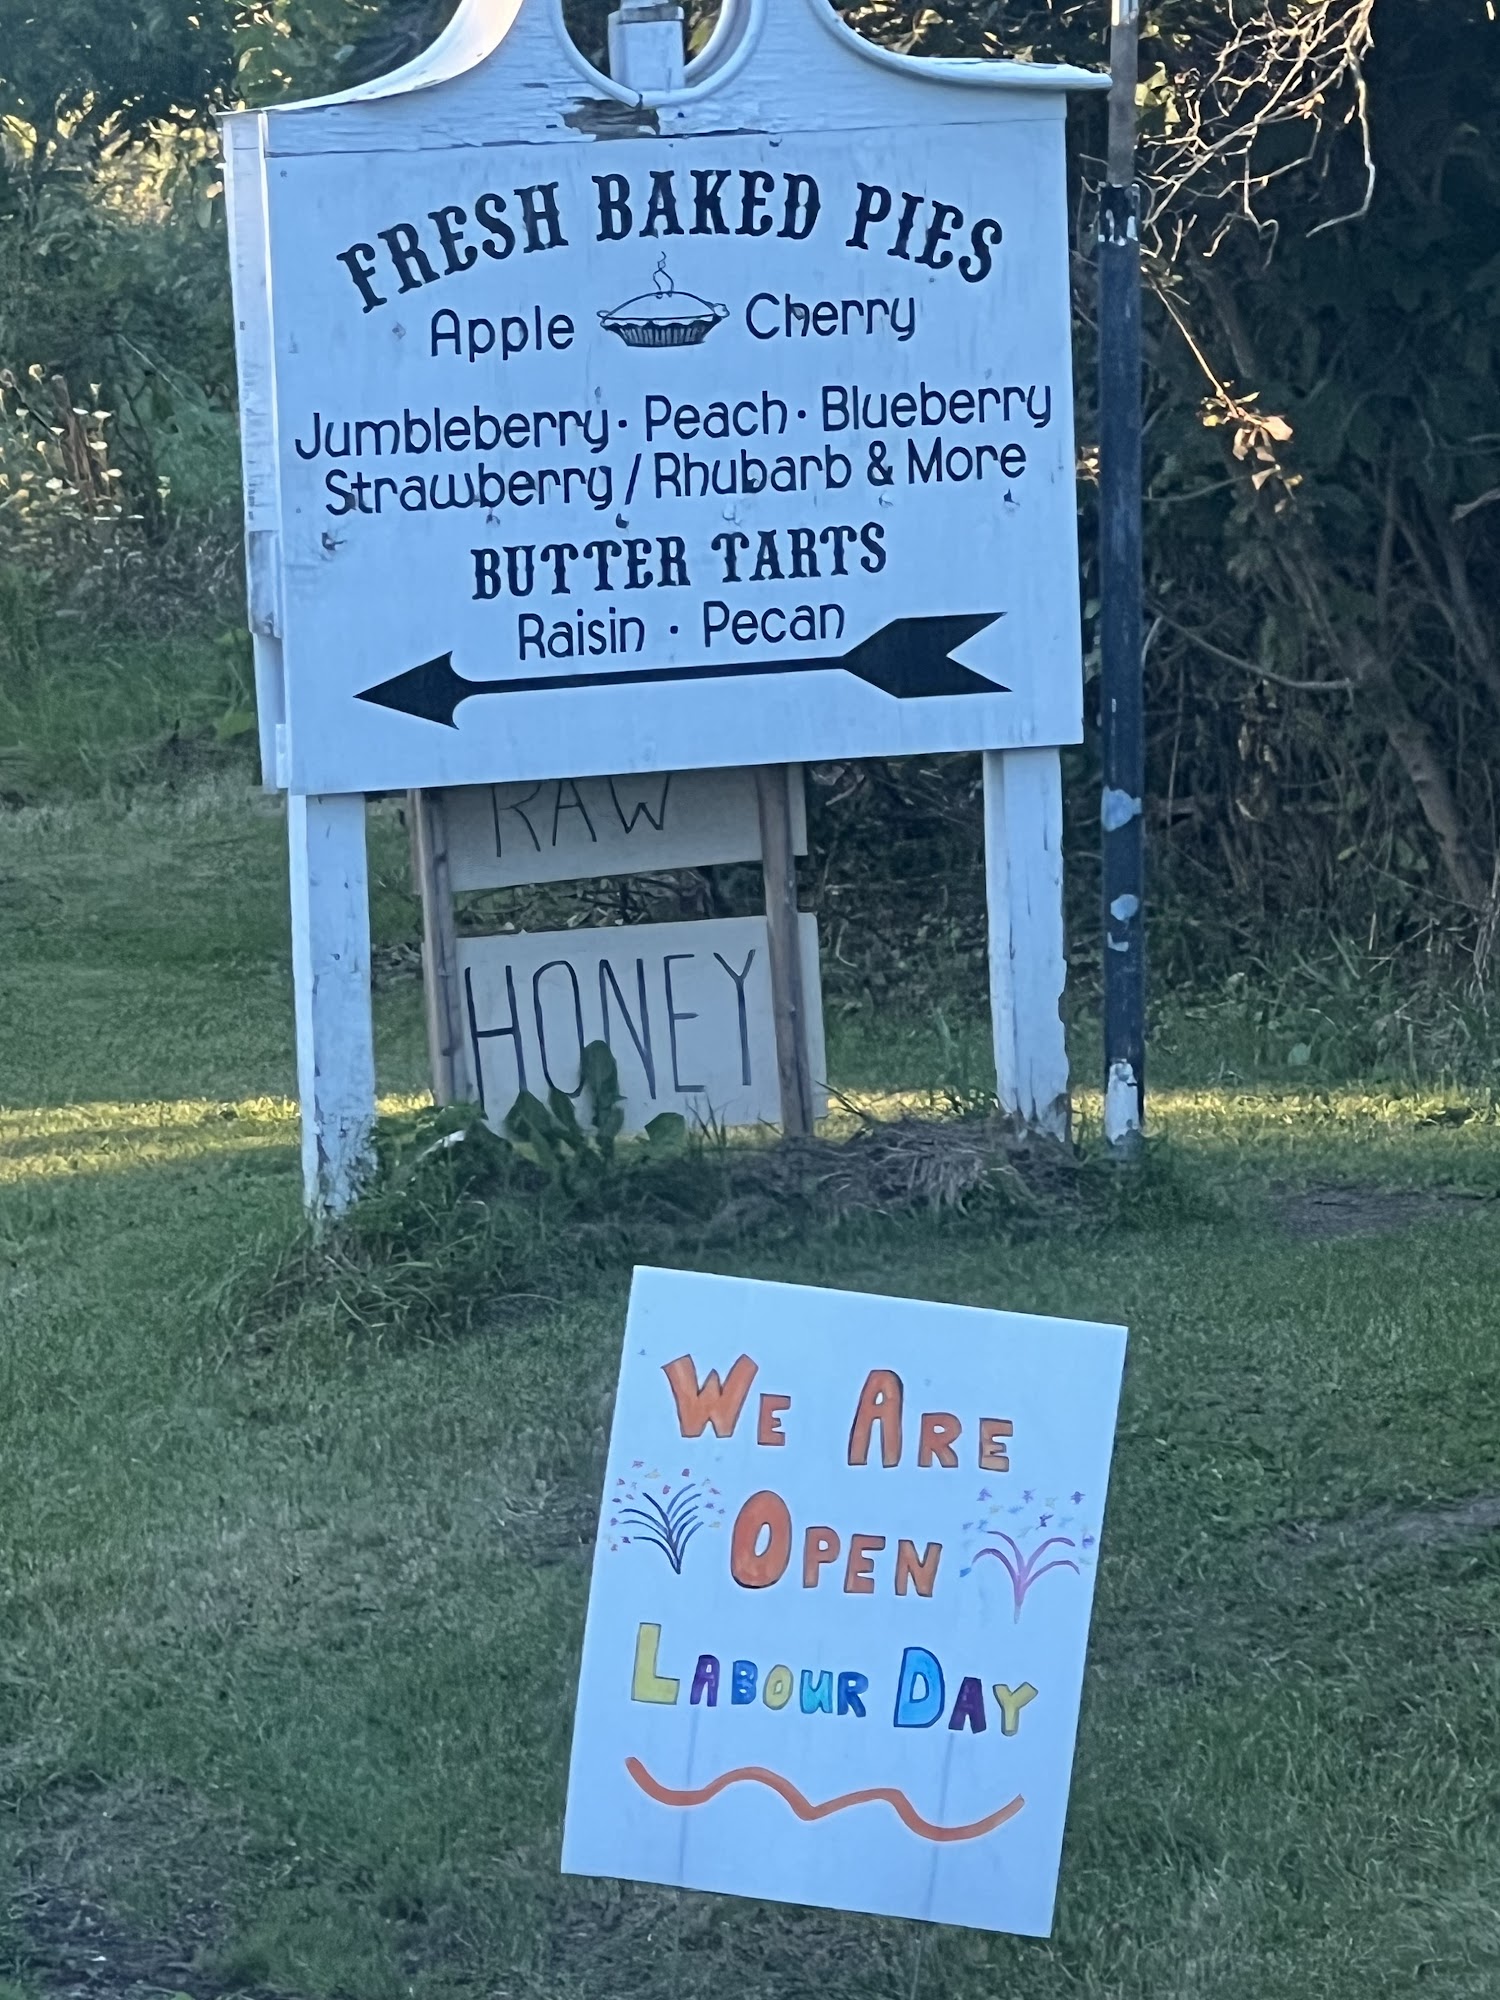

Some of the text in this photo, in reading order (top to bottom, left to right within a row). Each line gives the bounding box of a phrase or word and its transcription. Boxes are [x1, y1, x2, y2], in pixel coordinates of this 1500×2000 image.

[335, 169, 1003, 314] FRESH BAKED PIES
[430, 304, 575, 363] Apple
[745, 292, 916, 342] Cherry
[294, 405, 609, 460] Jumbleberry
[645, 390, 788, 442] Peach
[821, 381, 1052, 432] Blueberry
[324, 461, 613, 516] Strawberry
[653, 443, 852, 499] Rhubarb
[866, 440, 895, 487] &
[907, 436, 1027, 485] More
[470, 521, 887, 601] BUTTER TARTS
[518, 607, 645, 661] Raisin
[703, 600, 845, 648] Pecan
[491, 774, 671, 858] RAW
[464, 948, 757, 1119] HONEY
